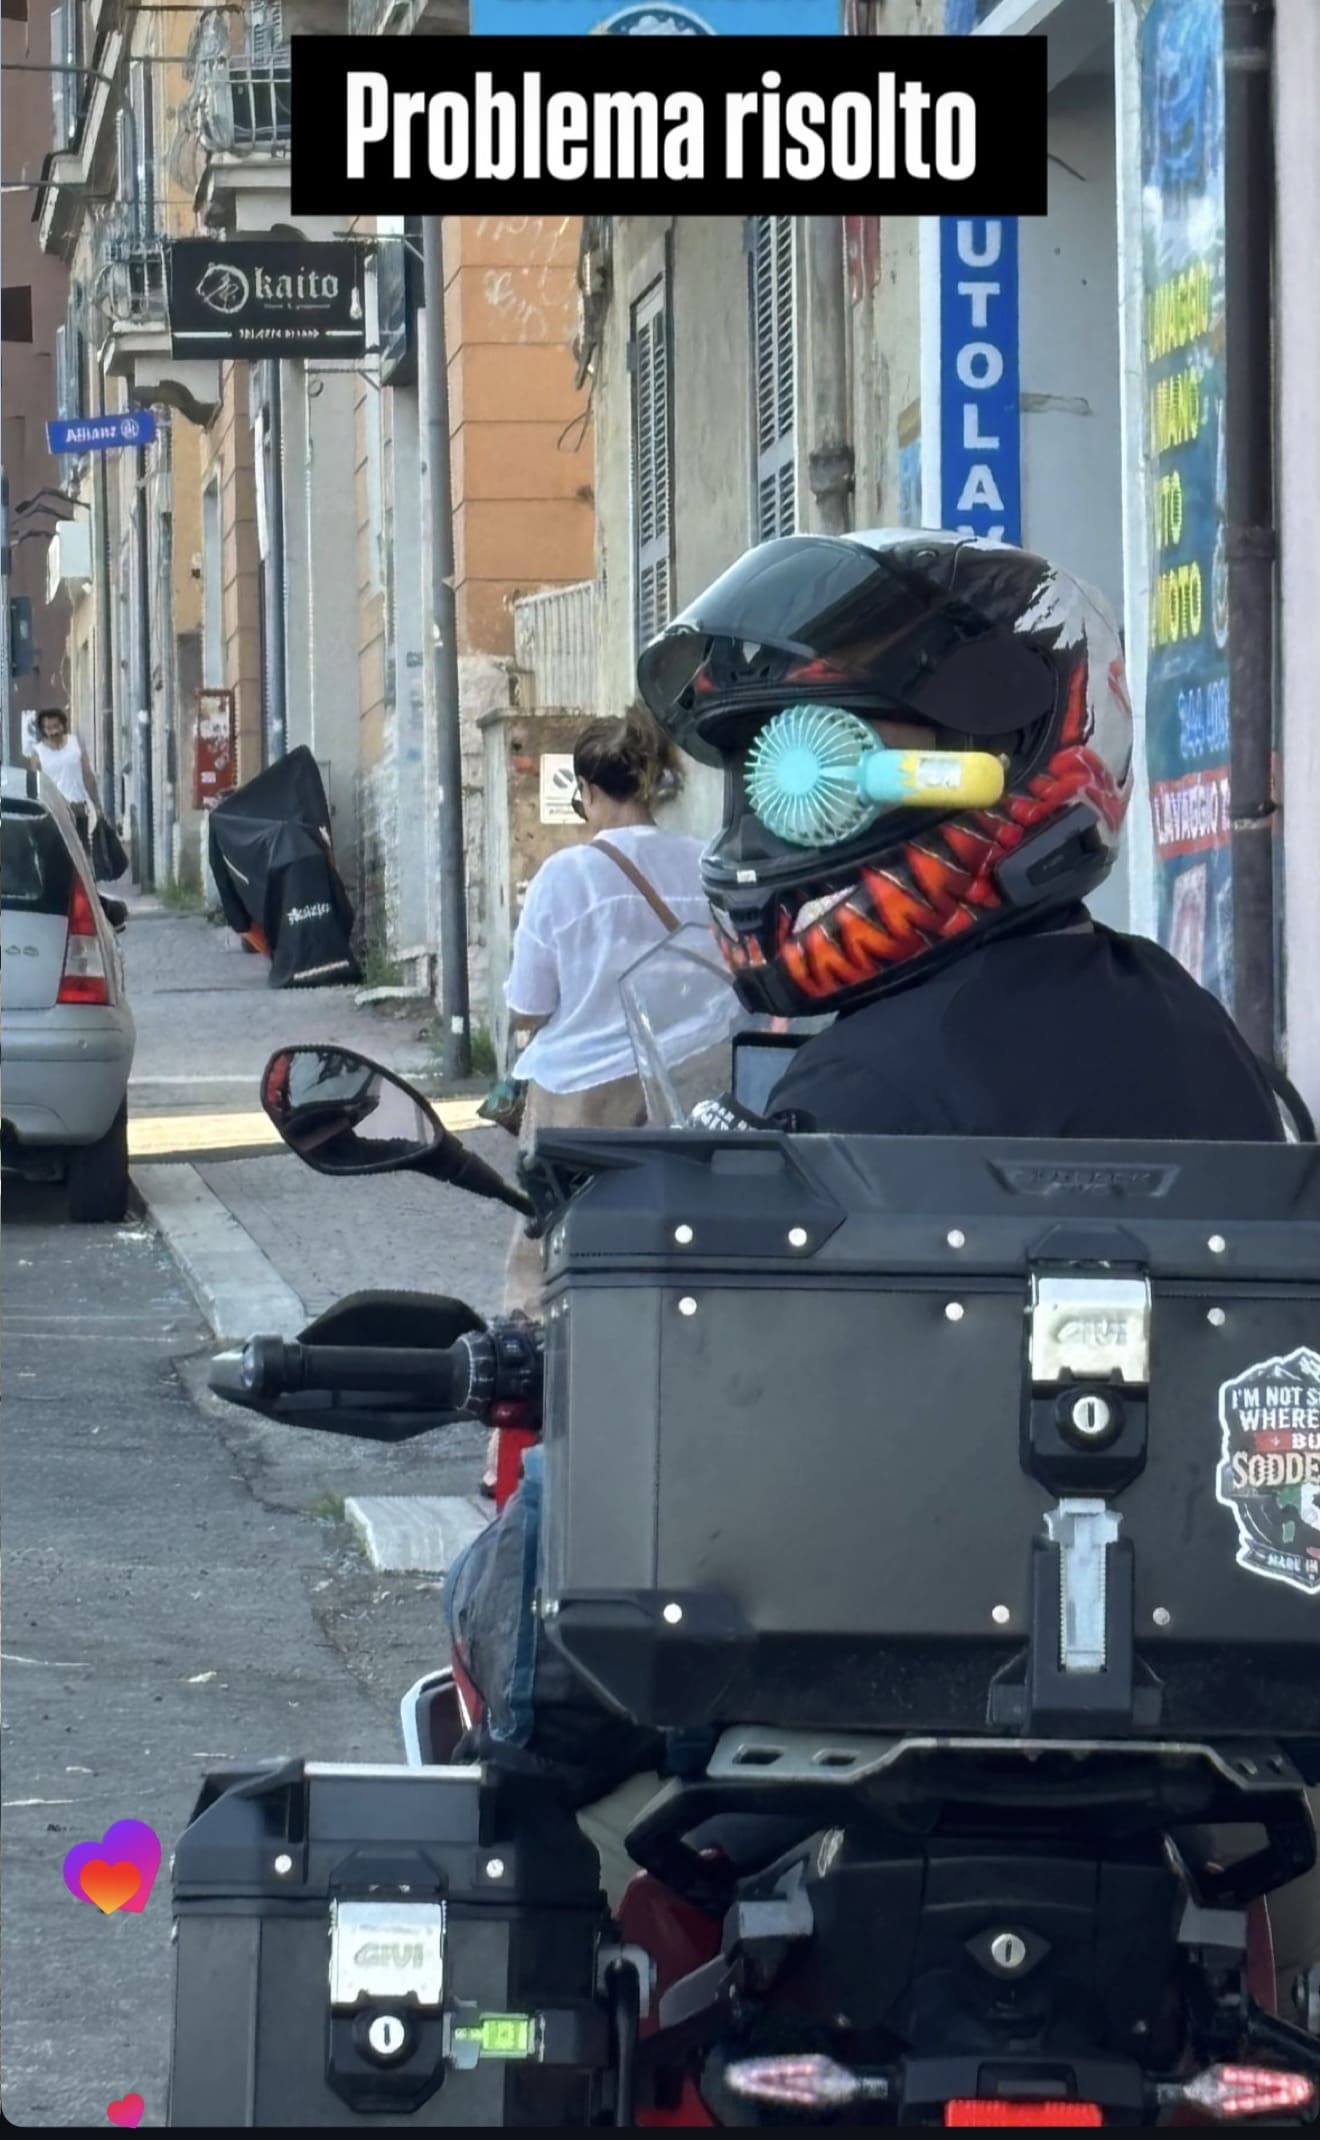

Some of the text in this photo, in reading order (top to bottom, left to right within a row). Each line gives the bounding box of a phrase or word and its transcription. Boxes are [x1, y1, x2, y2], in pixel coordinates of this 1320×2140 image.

[254, 265, 339, 299] kaito
[65, 425, 117, 443] Allianz
[1231, 1387, 1260, 1409] I'M
[1266, 1386, 1304, 1407] NOT
[1239, 1407, 1320, 1432] WHERE
